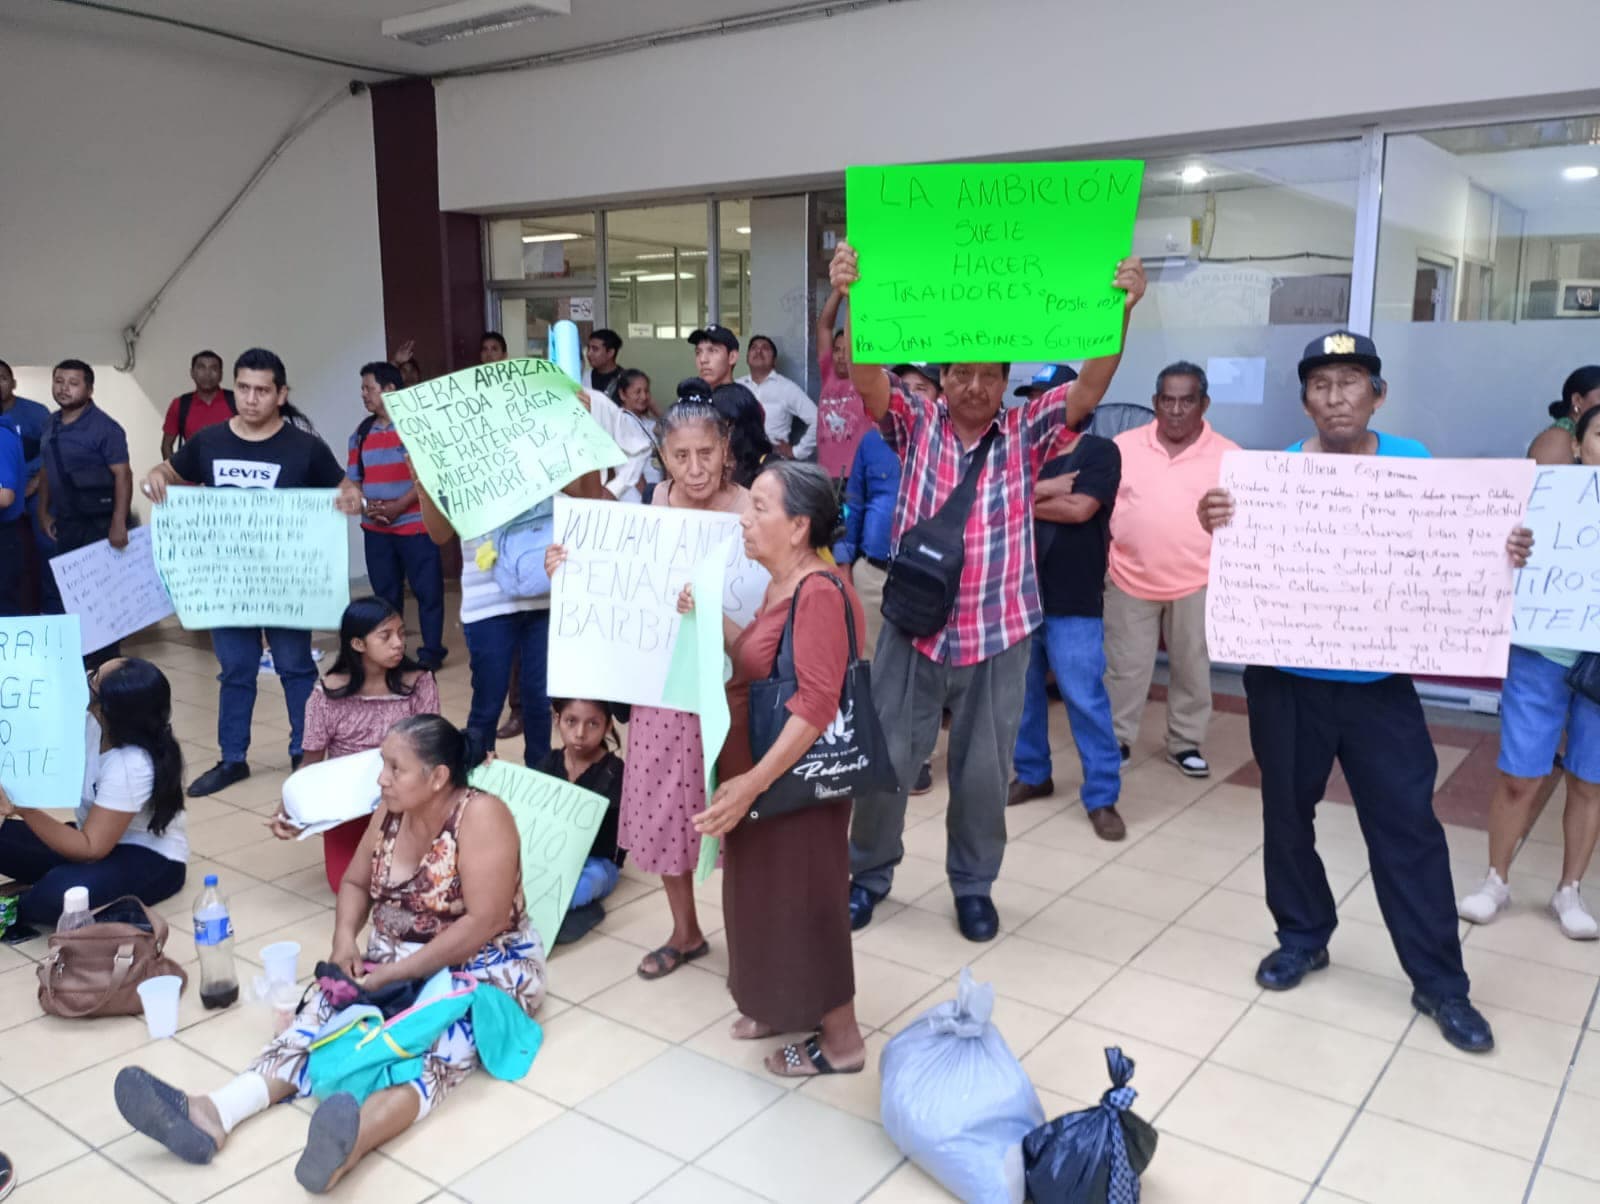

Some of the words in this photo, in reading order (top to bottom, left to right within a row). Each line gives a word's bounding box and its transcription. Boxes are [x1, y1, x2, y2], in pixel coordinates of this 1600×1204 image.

[880, 172, 935, 209] LA
[957, 168, 1136, 209] AMBICIÓN
[952, 252, 1043, 278] HACER
[385, 376, 465, 413] FUERA
[399, 415, 432, 436] CON
[436, 392, 492, 425] TODA
[502, 379, 528, 402] SU
[415, 417, 492, 454] MALDITA
[505, 389, 562, 421] PLAGA
[429, 453, 446, 470] DE
[456, 416, 536, 461] RATEROS
[436, 446, 518, 491] MUERTOS
[562, 508, 660, 562] WILIAM
